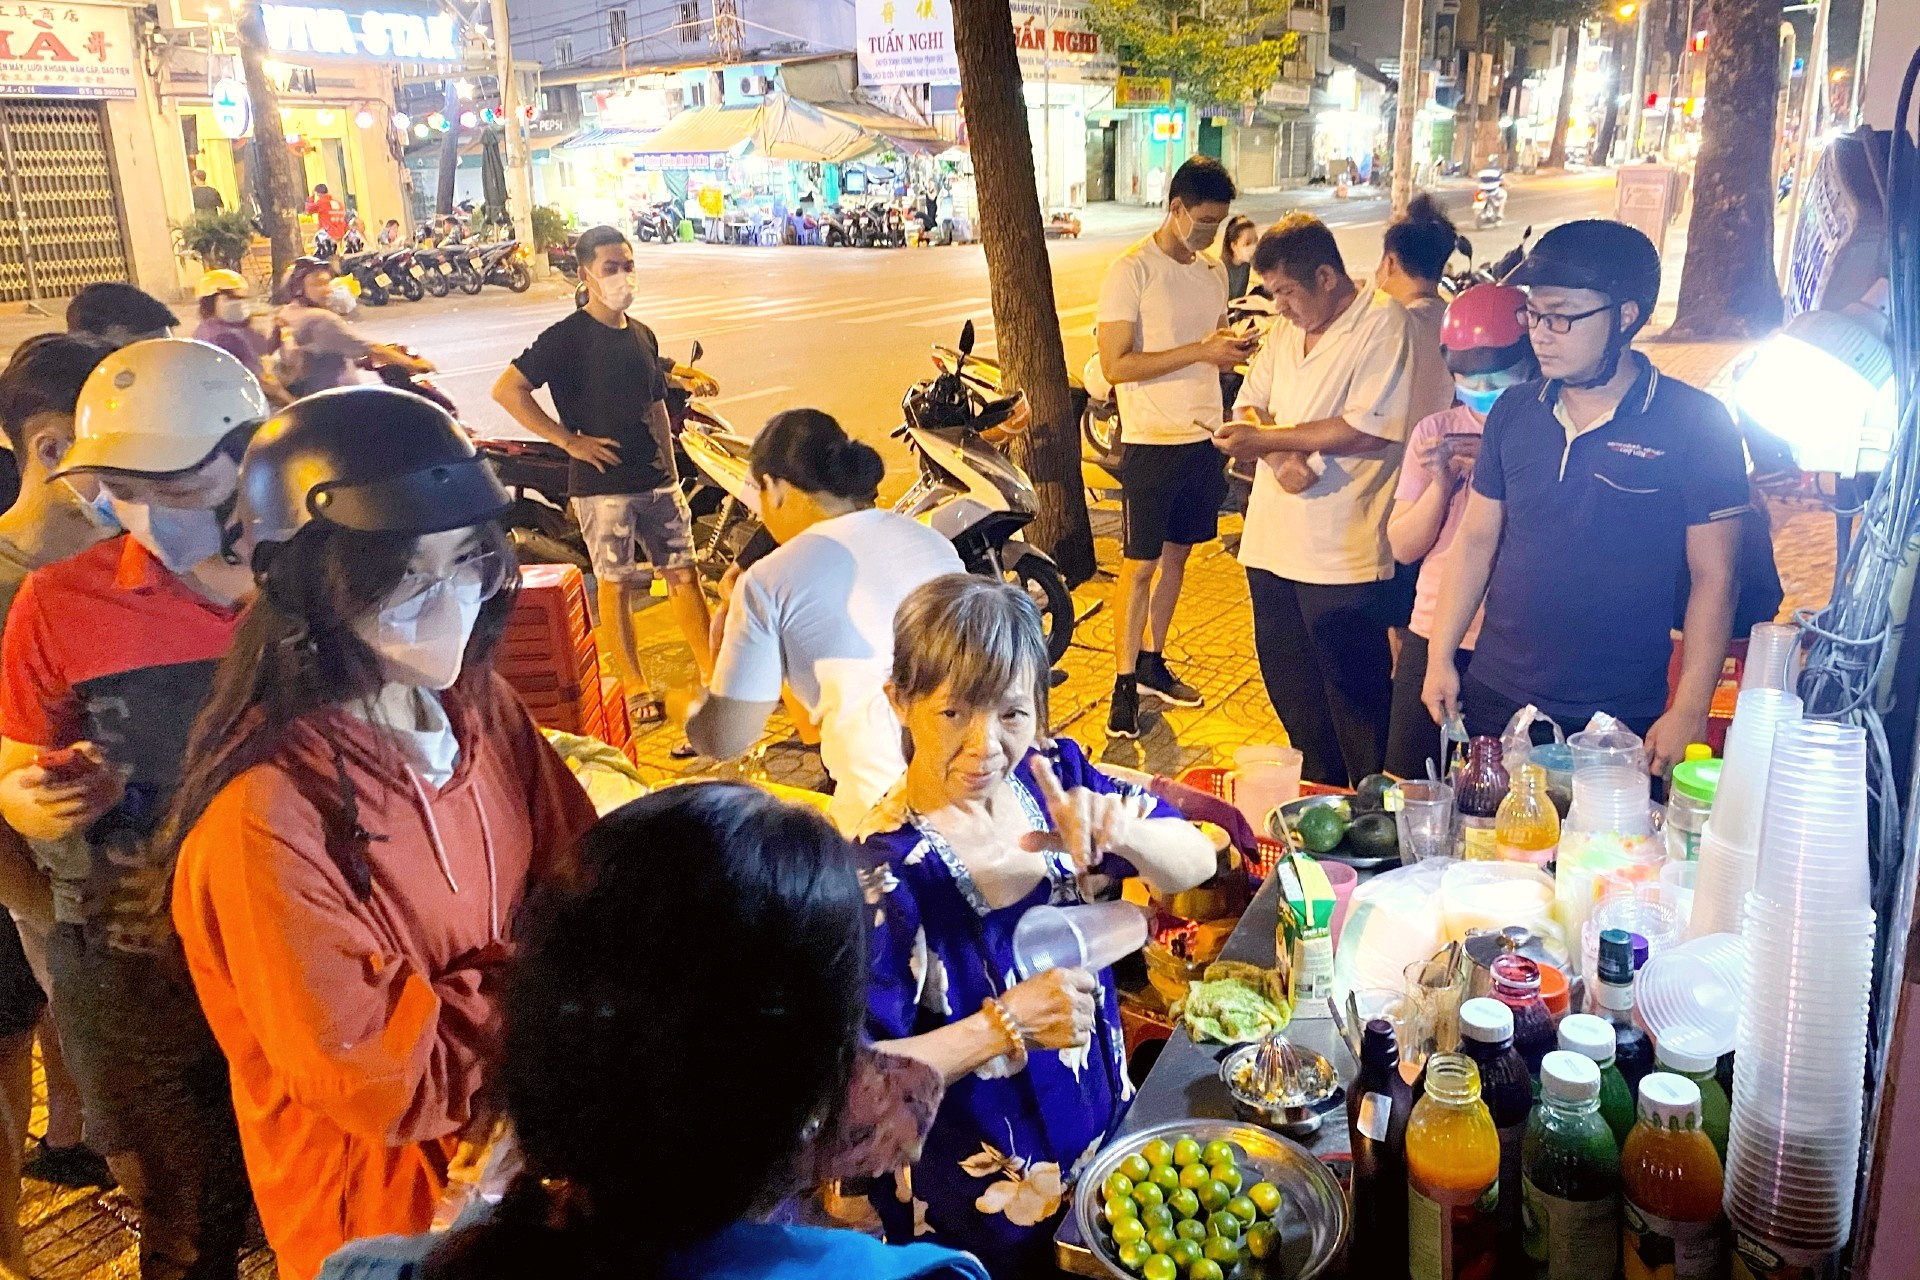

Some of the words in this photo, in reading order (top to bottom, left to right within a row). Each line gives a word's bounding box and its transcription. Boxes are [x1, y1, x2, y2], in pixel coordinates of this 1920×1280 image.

[259, 4, 358, 54] VIVA
[361, 10, 457, 60] STAR
[868, 28, 904, 54] TUẤN
[909, 32, 944, 51] NGHI
[1014, 16, 1045, 50] UẤN
[1053, 30, 1099, 54] NGHI
[539, 119, 563, 132] PEPSI
